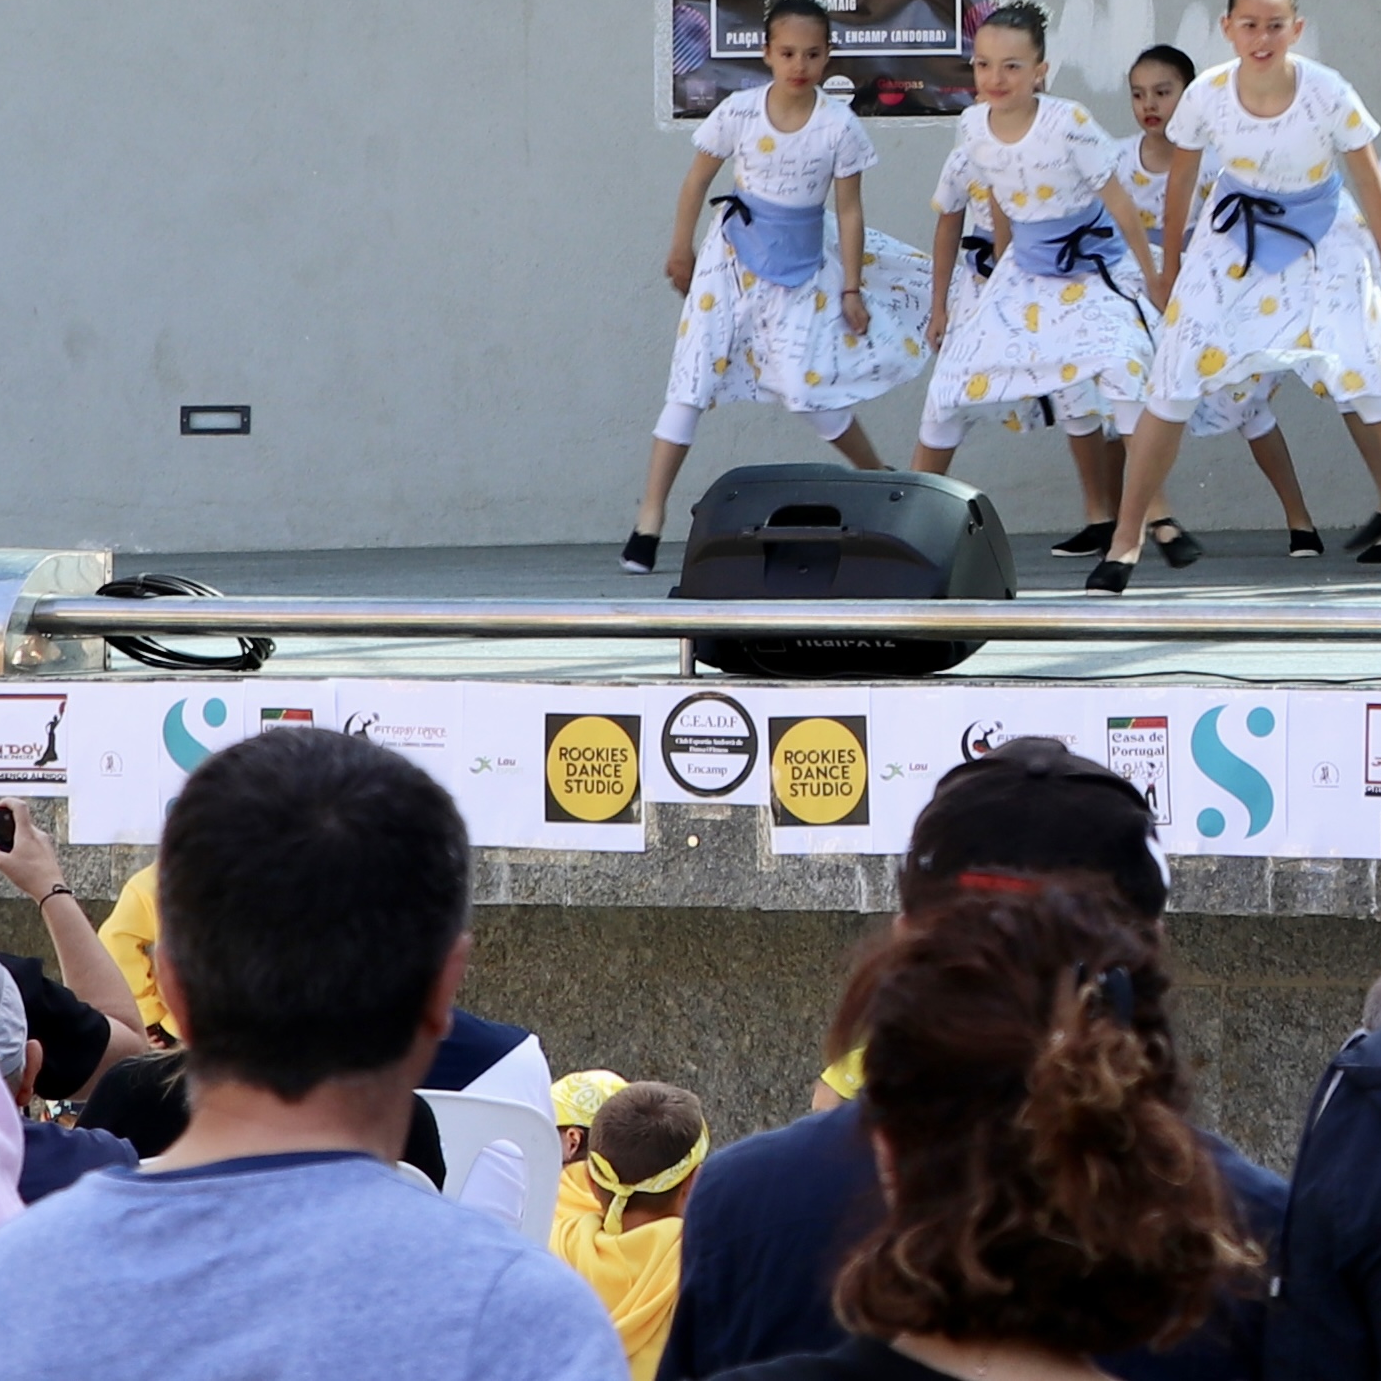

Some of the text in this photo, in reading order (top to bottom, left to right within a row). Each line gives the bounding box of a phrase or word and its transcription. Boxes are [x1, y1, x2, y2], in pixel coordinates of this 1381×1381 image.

[725, 31, 759, 48] PLAÇA
[845, 30, 887, 43] ENCAMP
[890, 30, 947, 43] (ANDORRA)
[679, 714, 739, 728] C.E.A.D.F
[1112, 731, 1164, 743] Casa de
[558, 747, 629, 763] ROOKIES
[783, 749, 856, 766] ROOKIES
[1111, 745, 1165, 758] Portugal
[566, 763, 622, 778] DANCE
[687, 763, 728, 777] Encamp
[791, 764, 850, 780] DANCE
[564, 779, 624, 795] STUDIO
[789, 781, 853, 798] STUDIO
